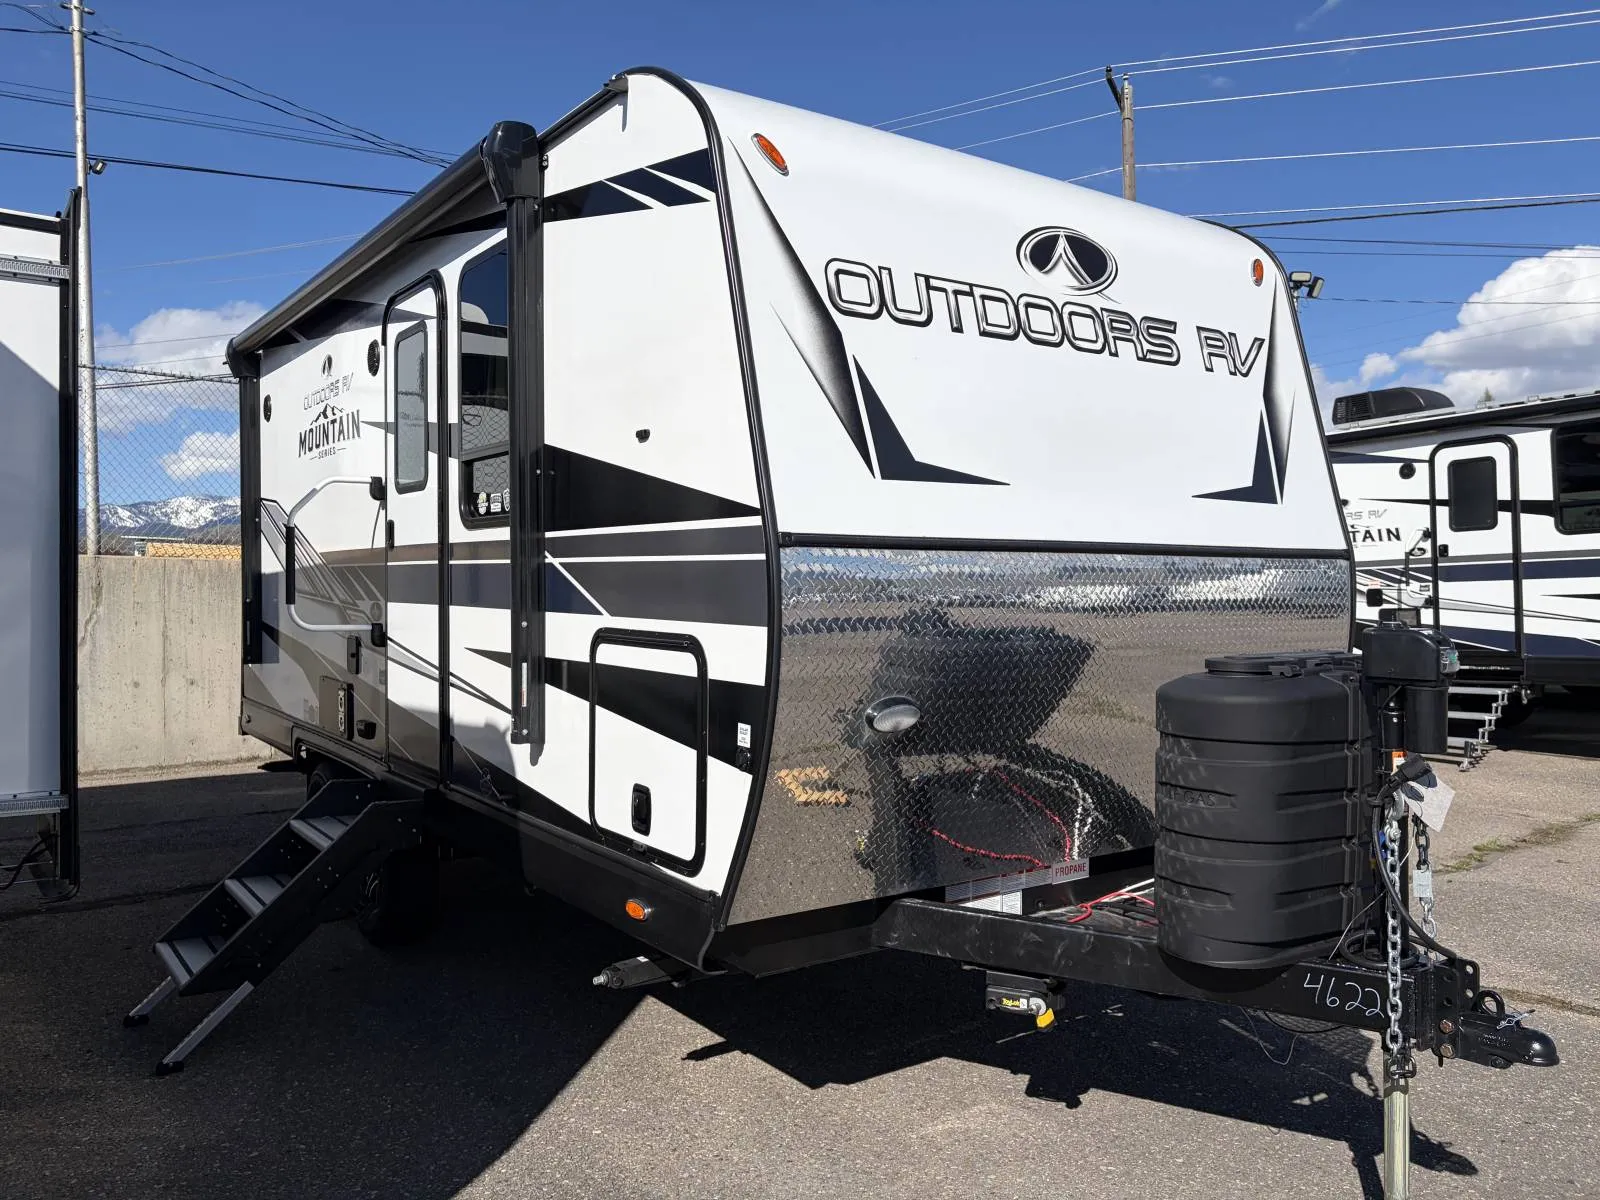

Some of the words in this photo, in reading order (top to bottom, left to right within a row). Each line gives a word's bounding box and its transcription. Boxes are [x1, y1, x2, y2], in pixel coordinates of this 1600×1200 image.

[824, 257, 1181, 366] OUTDOORS
[1196, 325, 1266, 378] RV
[303, 379, 340, 411] OUTDOORS
[342, 371, 354, 394] RV
[298, 409, 361, 458] MOUNTAIN
[318, 446, 337, 459] SERIES
[1349, 527, 1402, 543] TAIN
[1183, 790, 1216, 807] GAS
[1055, 862, 1087, 877] PROPANE
[1303, 972, 1385, 1019] 4622
